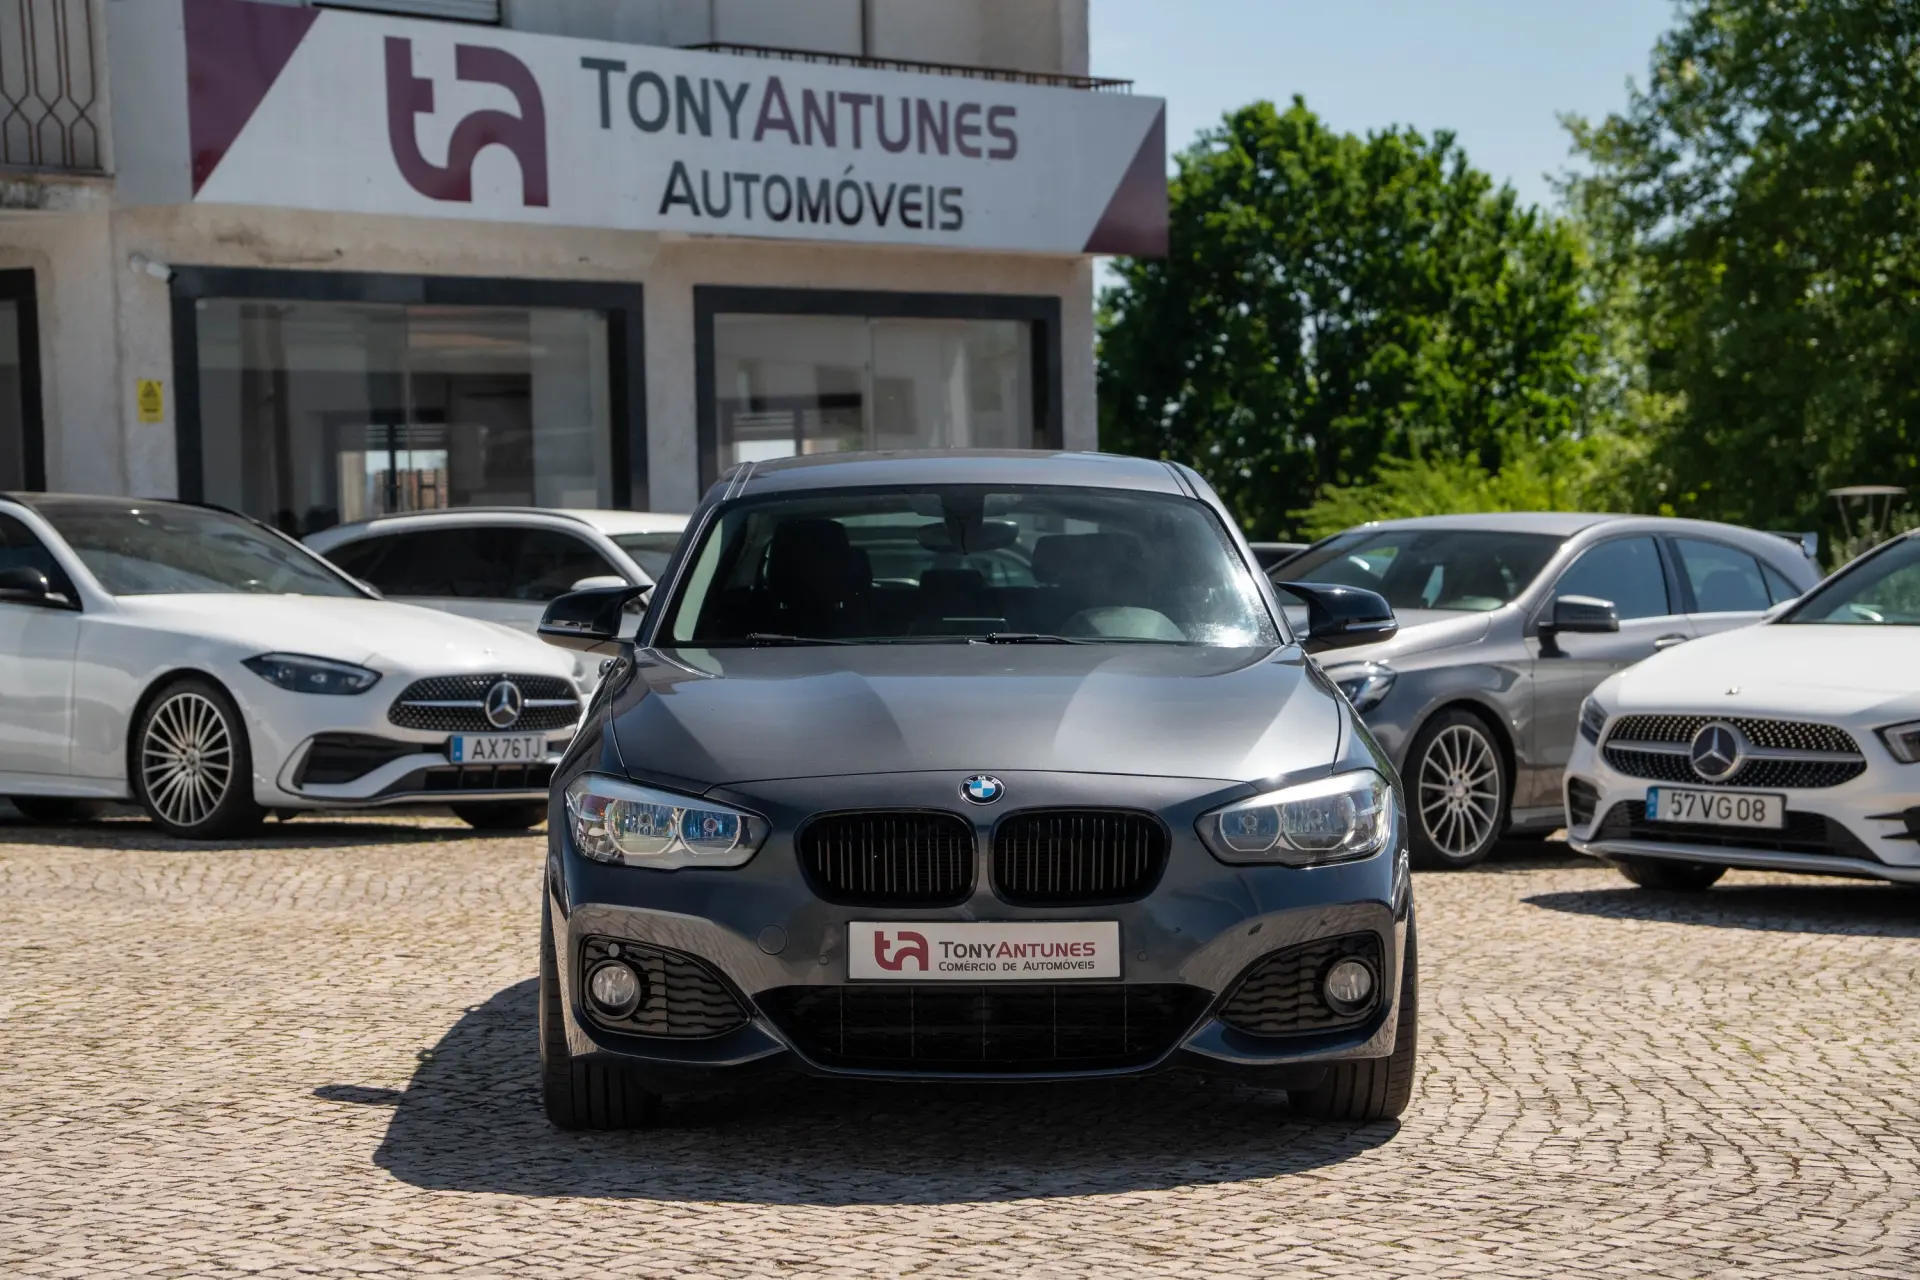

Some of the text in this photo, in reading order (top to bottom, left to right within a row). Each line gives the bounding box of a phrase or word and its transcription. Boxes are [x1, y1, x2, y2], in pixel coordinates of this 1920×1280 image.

[658, 160, 963, 231] AUTOMÓVEIS
[471, 738, 541, 760] AX76TJ
[1671, 792, 1766, 822] 57VG08
[939, 959, 1095, 972] COMÉRCIO DE AUTOMÓVEIS
